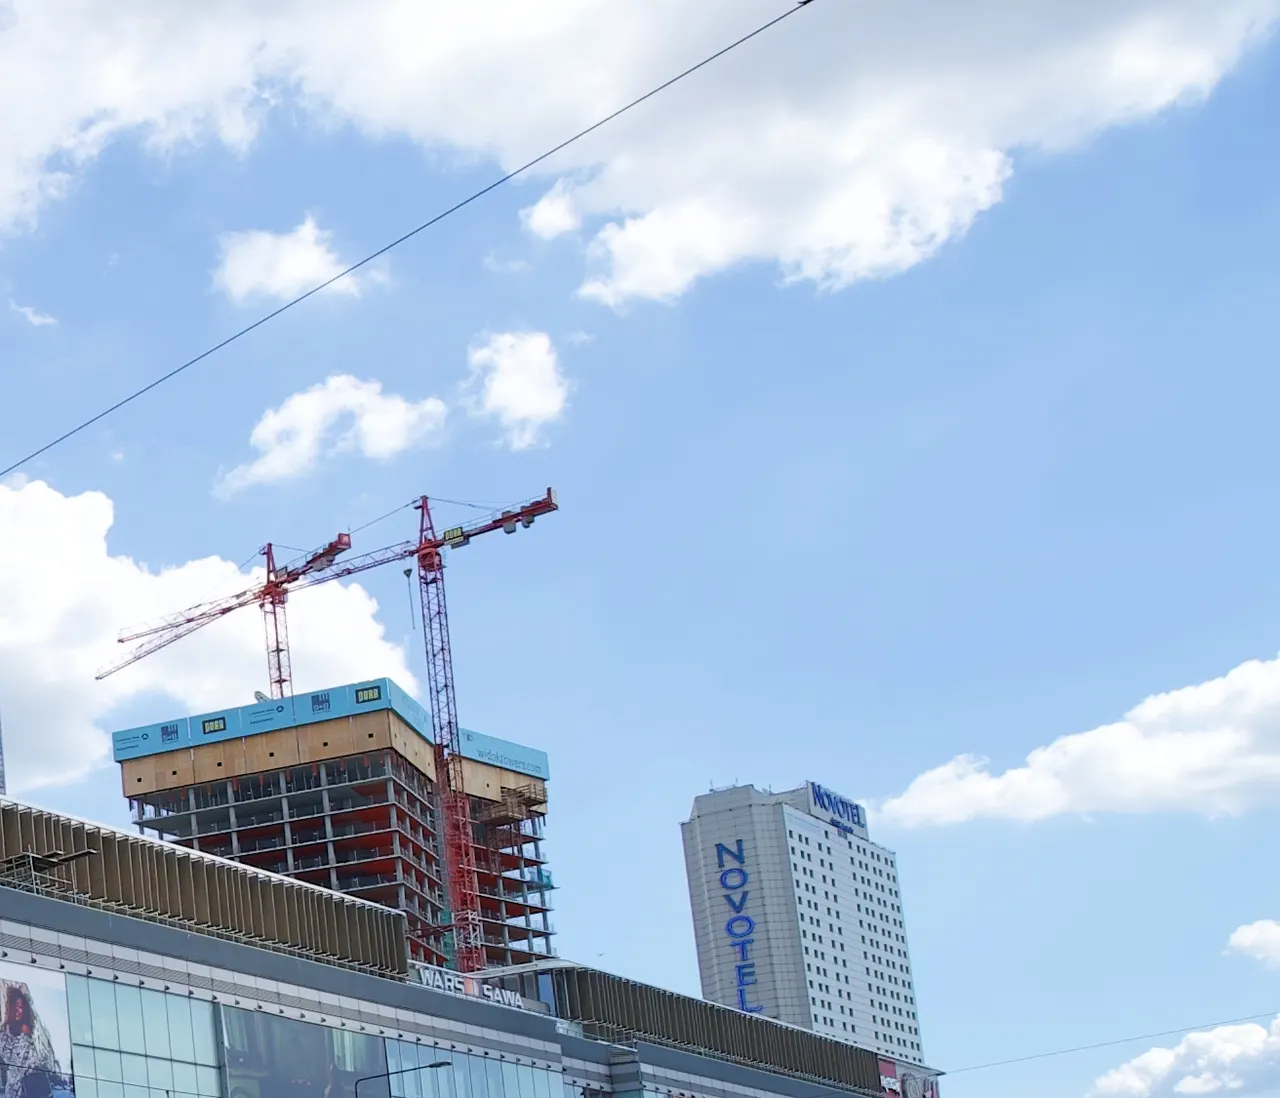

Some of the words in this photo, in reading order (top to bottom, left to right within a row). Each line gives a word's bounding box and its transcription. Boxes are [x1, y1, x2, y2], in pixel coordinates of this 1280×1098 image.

[810, 782, 866, 829] NOVOTEL
[714, 838, 762, 1013] NOVOTEL
[419, 967, 465, 993] WARS
[482, 984, 524, 1009] SAWA
